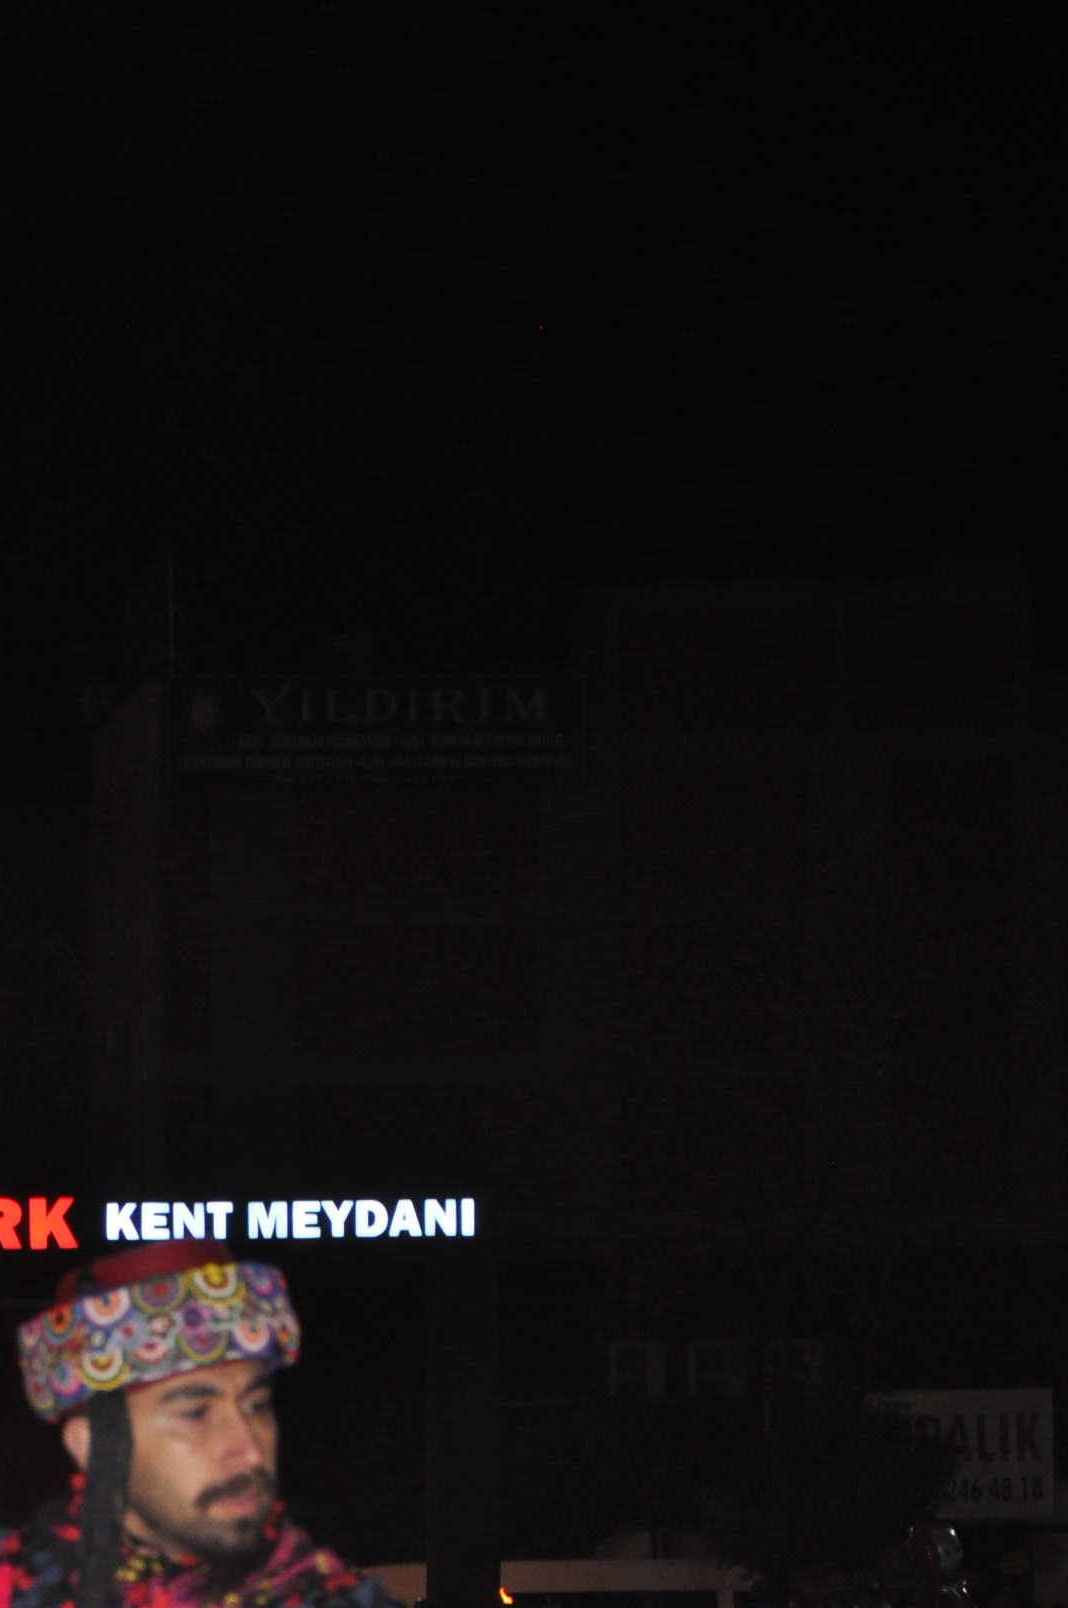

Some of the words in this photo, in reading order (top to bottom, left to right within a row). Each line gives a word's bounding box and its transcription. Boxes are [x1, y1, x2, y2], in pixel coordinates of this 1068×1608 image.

[249, 681, 550, 723] YILDIRIM
[105, 1201, 234, 1241] KENT
[247, 1198, 475, 1239] MEYDANI
